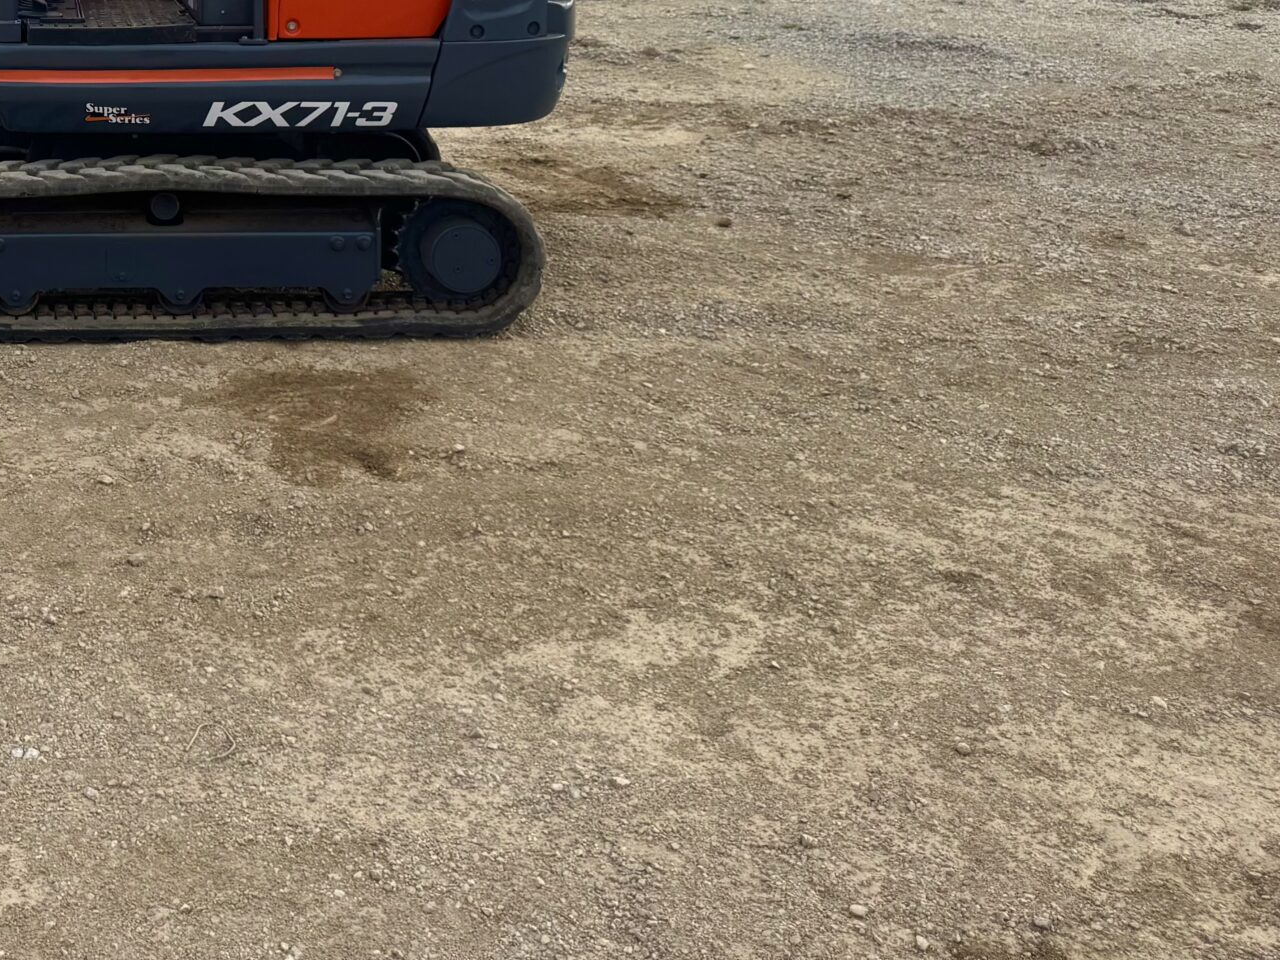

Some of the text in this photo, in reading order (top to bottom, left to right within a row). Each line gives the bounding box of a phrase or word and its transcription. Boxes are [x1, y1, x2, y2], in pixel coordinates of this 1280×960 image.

[85, 102, 127, 116] Super
[202, 101, 398, 127] KX71-3
[108, 113, 150, 124] Series
